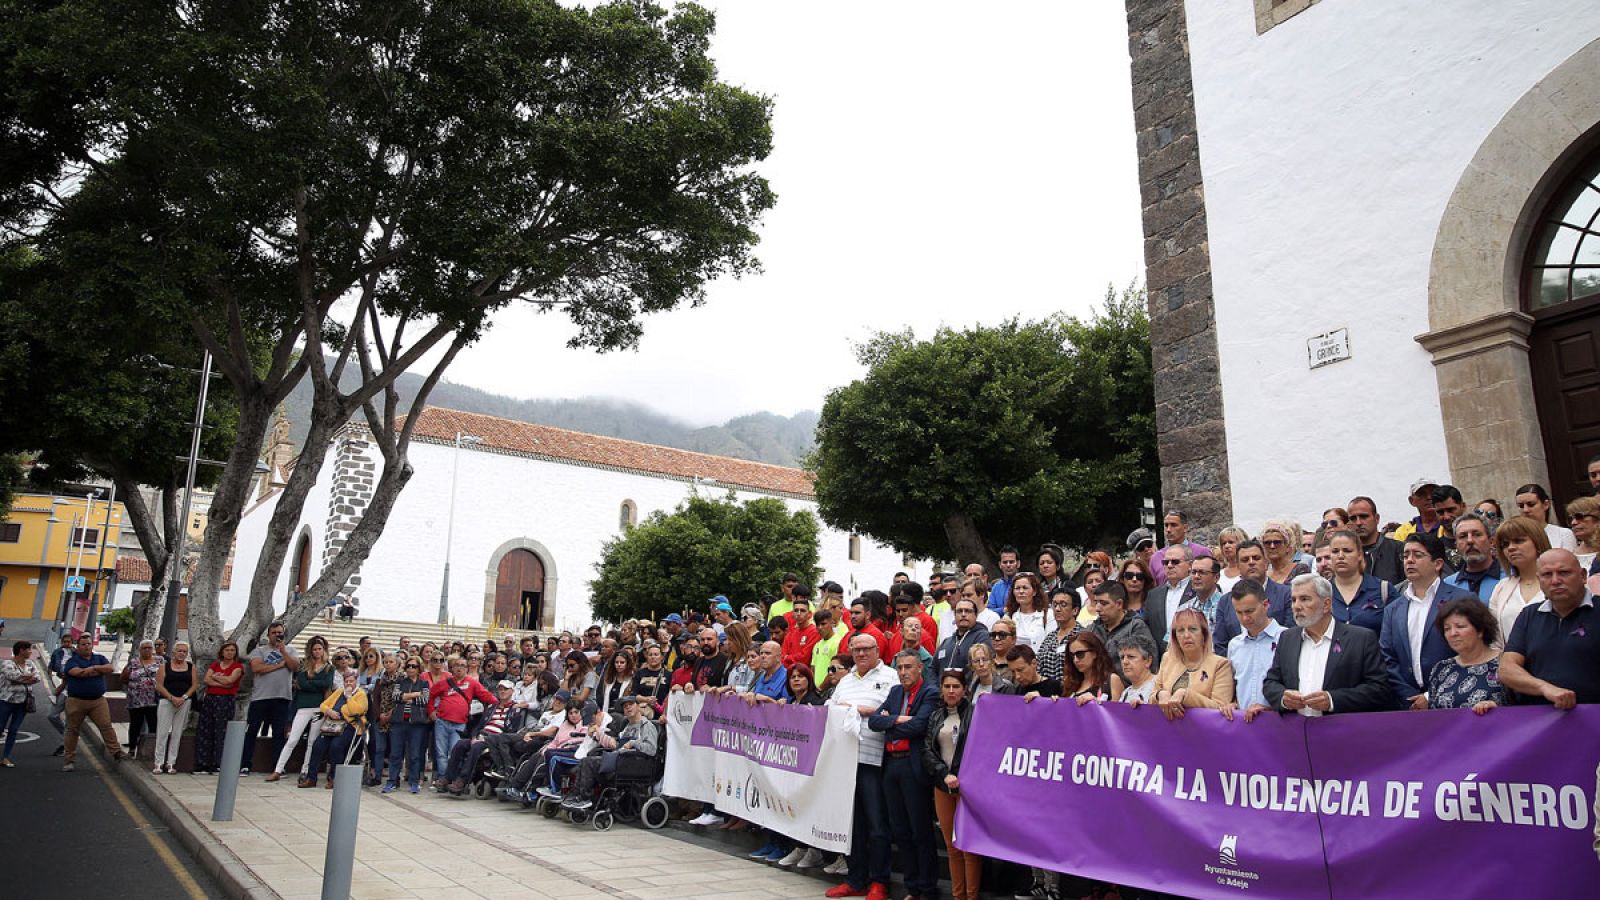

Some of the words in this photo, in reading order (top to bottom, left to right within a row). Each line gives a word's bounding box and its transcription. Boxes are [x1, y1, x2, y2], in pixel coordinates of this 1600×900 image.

[998, 746, 1065, 782] ADEJE
[1071, 754, 1164, 796] CONTRA
[1174, 767, 1208, 802] LA
[1219, 771, 1370, 817] VIOLENCIA
[1383, 780, 1424, 819] DE
[1435, 772, 1589, 830] GÉNERO
[1204, 863, 1260, 880] Ayuntamiento
[1217, 876, 1225, 885] de
[1226, 877, 1249, 890] Adeje
